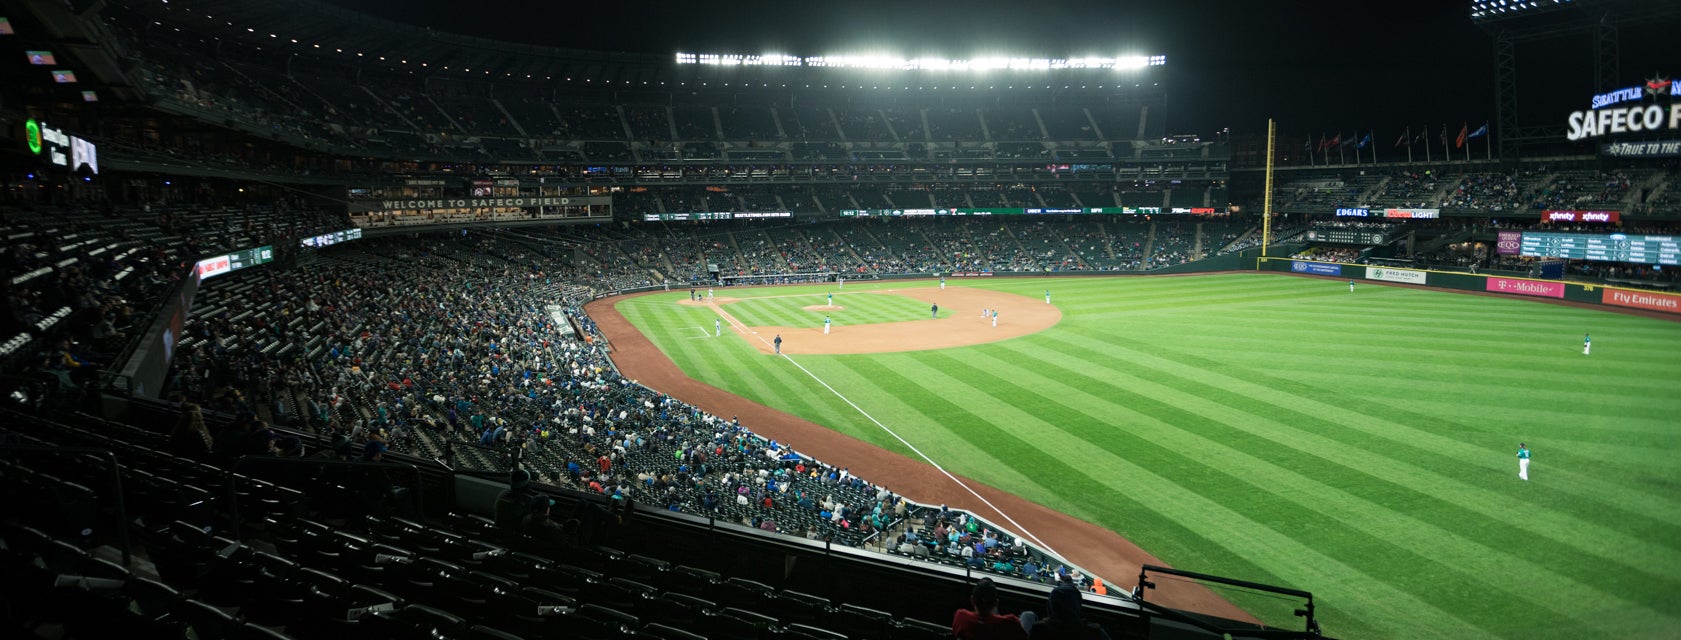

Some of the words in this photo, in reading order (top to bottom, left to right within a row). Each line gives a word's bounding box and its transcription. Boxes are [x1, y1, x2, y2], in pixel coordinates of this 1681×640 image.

[1592, 87, 1642, 109] SEATTLE
[1567, 105, 1664, 141] SAFECO
[1620, 142, 1646, 156] TRUE
[1646, 143, 1660, 155] TO
[1661, 142, 1681, 154] THE
[383, 200, 443, 209] WELCOME
[448, 199, 466, 208] TO
[472, 198, 524, 207] SAFECO
[530, 197, 570, 206] FIELD
[1411, 210, 1434, 219] LIGHT
[1549, 212, 1575, 221] xfinity
[1582, 212, 1609, 221] xfinity
[1613, 292, 1631, 304] Fly
[1632, 294, 1677, 308] Emirates
